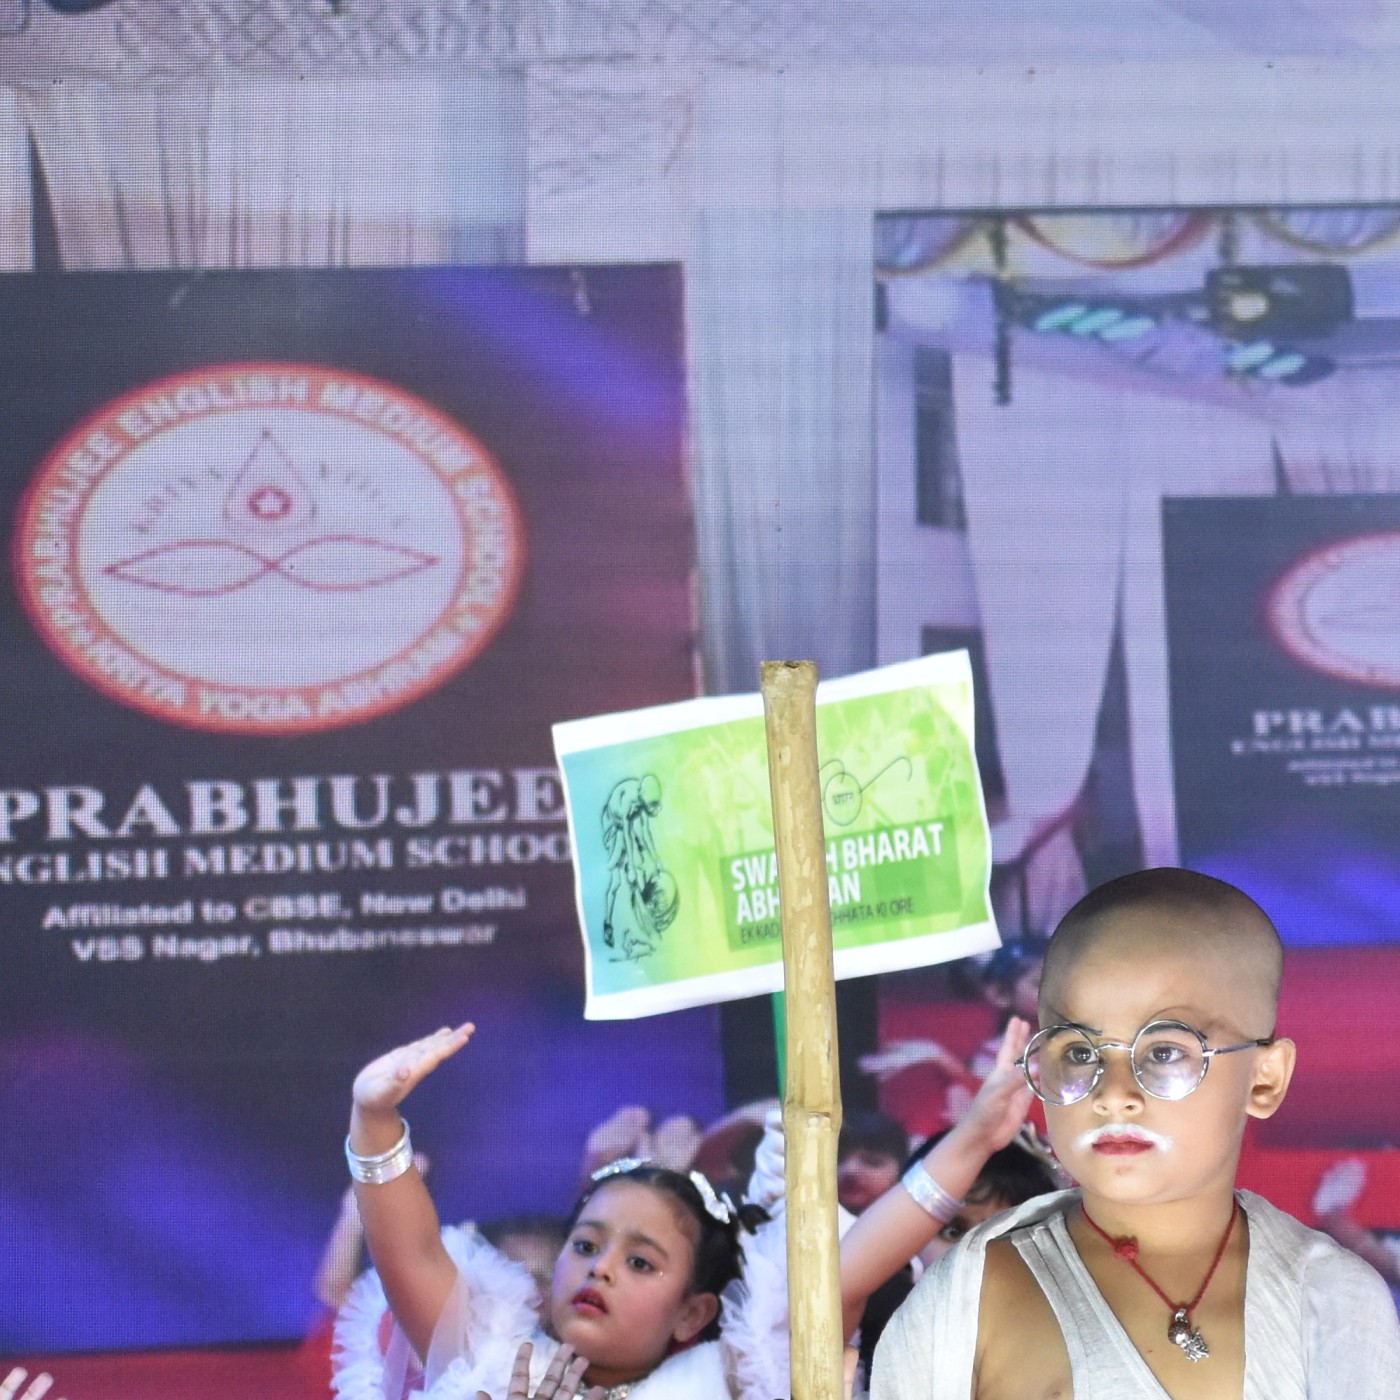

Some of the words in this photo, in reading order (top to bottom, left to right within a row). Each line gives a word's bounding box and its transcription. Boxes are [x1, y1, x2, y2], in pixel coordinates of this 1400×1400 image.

[115, 372, 308, 437] ENGLISH
[319, 380, 474, 472] MEDIUM
[199, 688, 312, 722] YOGA
[0, 767, 566, 842] PRABHUJEE
[183, 838, 394, 875] MEDIUM
[406, 832, 575, 869] SCHOO
[842, 823, 944, 870] BHARAT
[201, 899, 236, 923] to
